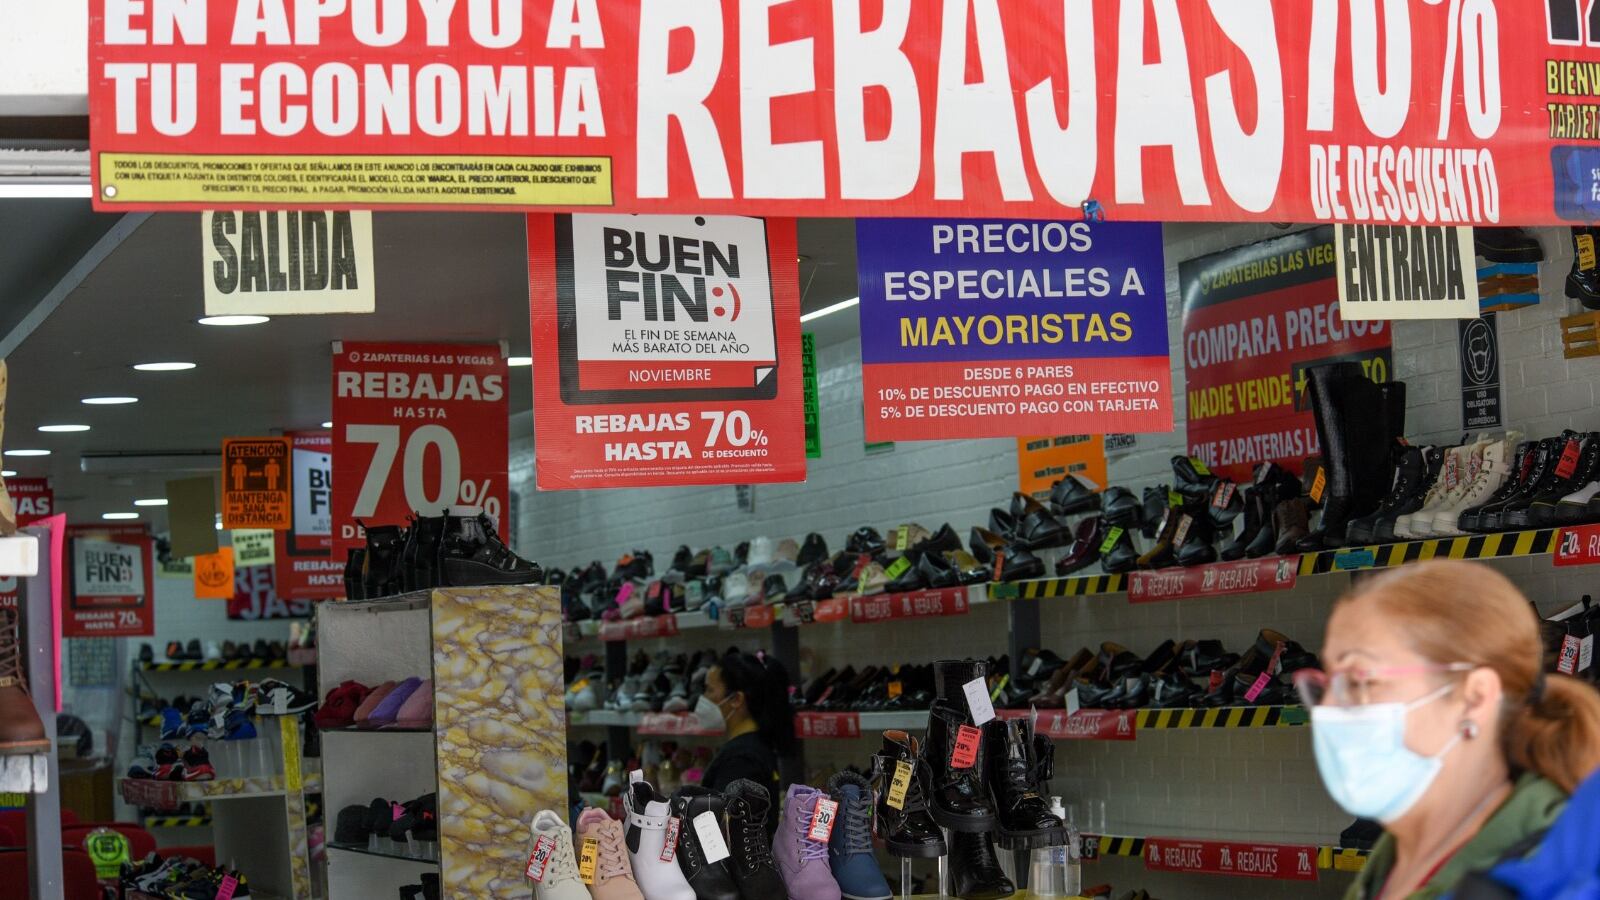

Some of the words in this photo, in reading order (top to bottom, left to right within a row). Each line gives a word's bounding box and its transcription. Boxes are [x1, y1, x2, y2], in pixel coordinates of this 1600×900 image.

[104, 0, 206, 45] EN
[231, 0, 522, 47] APOYO
[546, 0, 605, 48] A
[104, 63, 197, 136] TU
[220, 62, 606, 137] ECONOMIA
[636, 0, 1285, 213] REBAJAS
[1548, 104, 1600, 138] TARJET
[115, 172, 129, 180] CON
[469, 175, 494, 183] PRECIO
[583, 176, 596, 184] QUE
[294, 163, 307, 171] QUE
[354, 163, 363, 171] EN
[365, 163, 382, 171] ESTE
[384, 163, 415, 171] ANUNCIO
[416, 163, 430, 171] LOS
[516, 164, 548, 172] CALZADO
[550, 164, 563, 172] QUE
[1310, 144, 1347, 220] DE
[1348, 145, 1499, 223] DESCUENTO
[212, 210, 358, 294] SALIDA
[932, 222, 1092, 254] PRECIOS
[603, 227, 740, 278] BUEN
[1211, 256, 1279, 289] ZAPATERIAS
[1280, 251, 1303, 274] LAS
[1306, 243, 1335, 267] VEG
[1345, 225, 1465, 301] ENTRADA
[884, 267, 1110, 301] ESPECIALES
[1121, 267, 1145, 296] A
[625, 330, 637, 340] EL
[640, 330, 660, 341] FIN
[664, 330, 680, 341] DE
[683, 330, 736, 342] SEMANA
[900, 312, 1133, 347] MAYORISTAS
[1187, 314, 1281, 369] COMPARA
[362, 353, 430, 364] ZAPATERIAS
[432, 354, 453, 364] LAS
[457, 355, 494, 365] VEGAS
[612, 340, 639, 353] MÁS
[643, 342, 692, 354] BARATO
[696, 343, 717, 354] DEL
[720, 340, 749, 354] AÑO
[337, 371, 504, 402] REBAJAS
[629, 368, 711, 382] NOVIEMBRE
[964, 368, 1011, 381] DESDE
[1015, 367, 1023, 379] 6
[1027, 365, 1074, 379] PARES
[877, 388, 906, 401] 10%
[910, 387, 930, 400] DE
[933, 385, 1020, 400] DESCUENTO
[1024, 384, 1064, 397] PAGO
[1068, 383, 1087, 395] EN
[1091, 381, 1159, 395] EFECTIVO
[1190, 383, 1234, 420] NADIE
[1235, 373, 1292, 412] VENDE
[394, 407, 447, 419] HASTA
[575, 412, 690, 434] REBAJAS
[880, 406, 901, 419] 5%
[905, 405, 925, 418] DE
[929, 403, 1015, 417] DESCUENTO
[1019, 401, 1059, 415] PAGO
[1063, 400, 1094, 413] CON
[1097, 399, 1158, 412] TARJETA
[700, 410, 768, 448] 70%
[230, 444, 283, 457] ATENCIÓN
[605, 441, 692, 462] HASTA
[702, 450, 714, 459] DE
[716, 449, 768, 459] DESCUENTO
[1192, 442, 1218, 468] QUE
[1220, 428, 1303, 466] ZAPATERIAS
[346, 424, 501, 518] 70%
[228, 492, 283, 504] MANTENGA
[243, 503, 265, 512] SANA
[228, 512, 283, 522] DISTANCIA
[86, 551, 132, 567] BUEN
[1147, 576, 1184, 597] REBAJAS
[1218, 567, 1259, 590] REBAJAS
[1164, 847, 1202, 869] REBAJAS
[1237, 850, 1278, 874] REBAJAS
